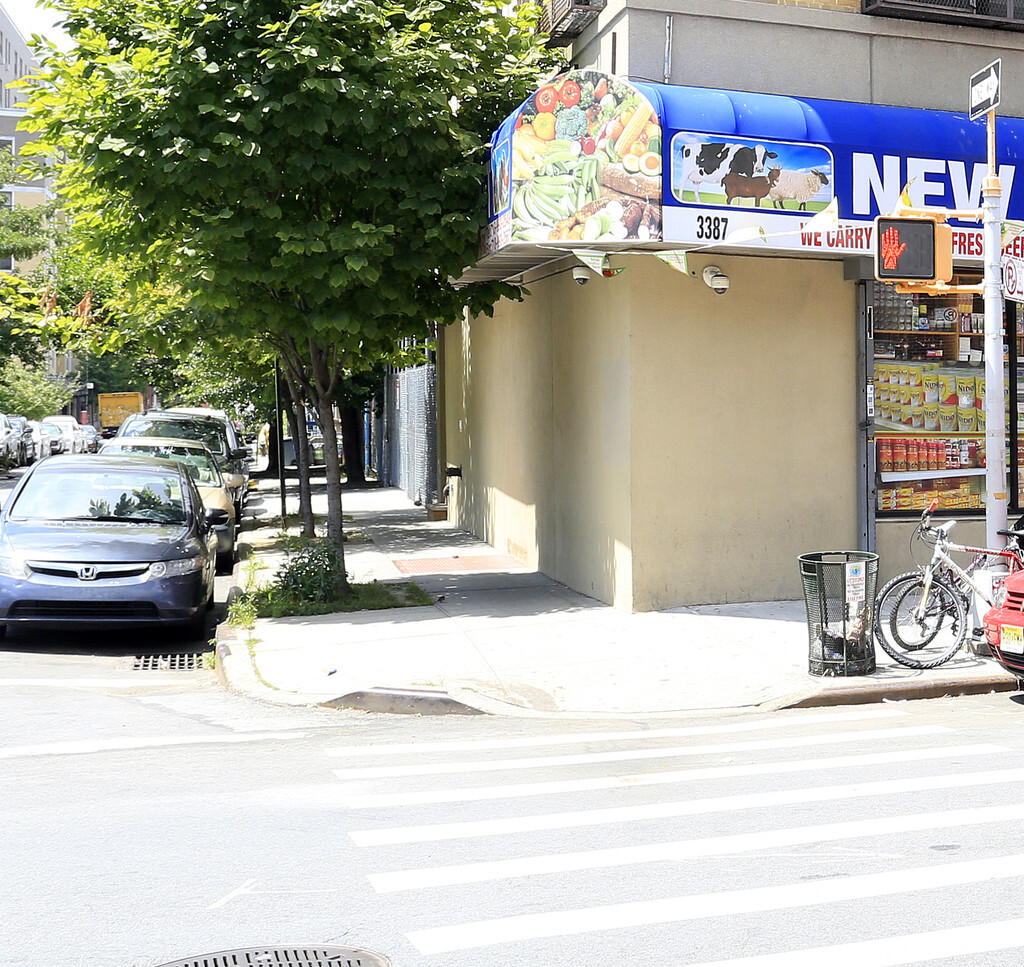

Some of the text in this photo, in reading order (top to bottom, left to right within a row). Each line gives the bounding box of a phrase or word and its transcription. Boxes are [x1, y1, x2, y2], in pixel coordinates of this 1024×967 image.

[852, 152, 1016, 220] NEW
[696, 215, 728, 240] 3387
[800, 222, 822, 247] WE
[826, 225, 873, 250] CARRY
[952, 232, 983, 256] FRES
